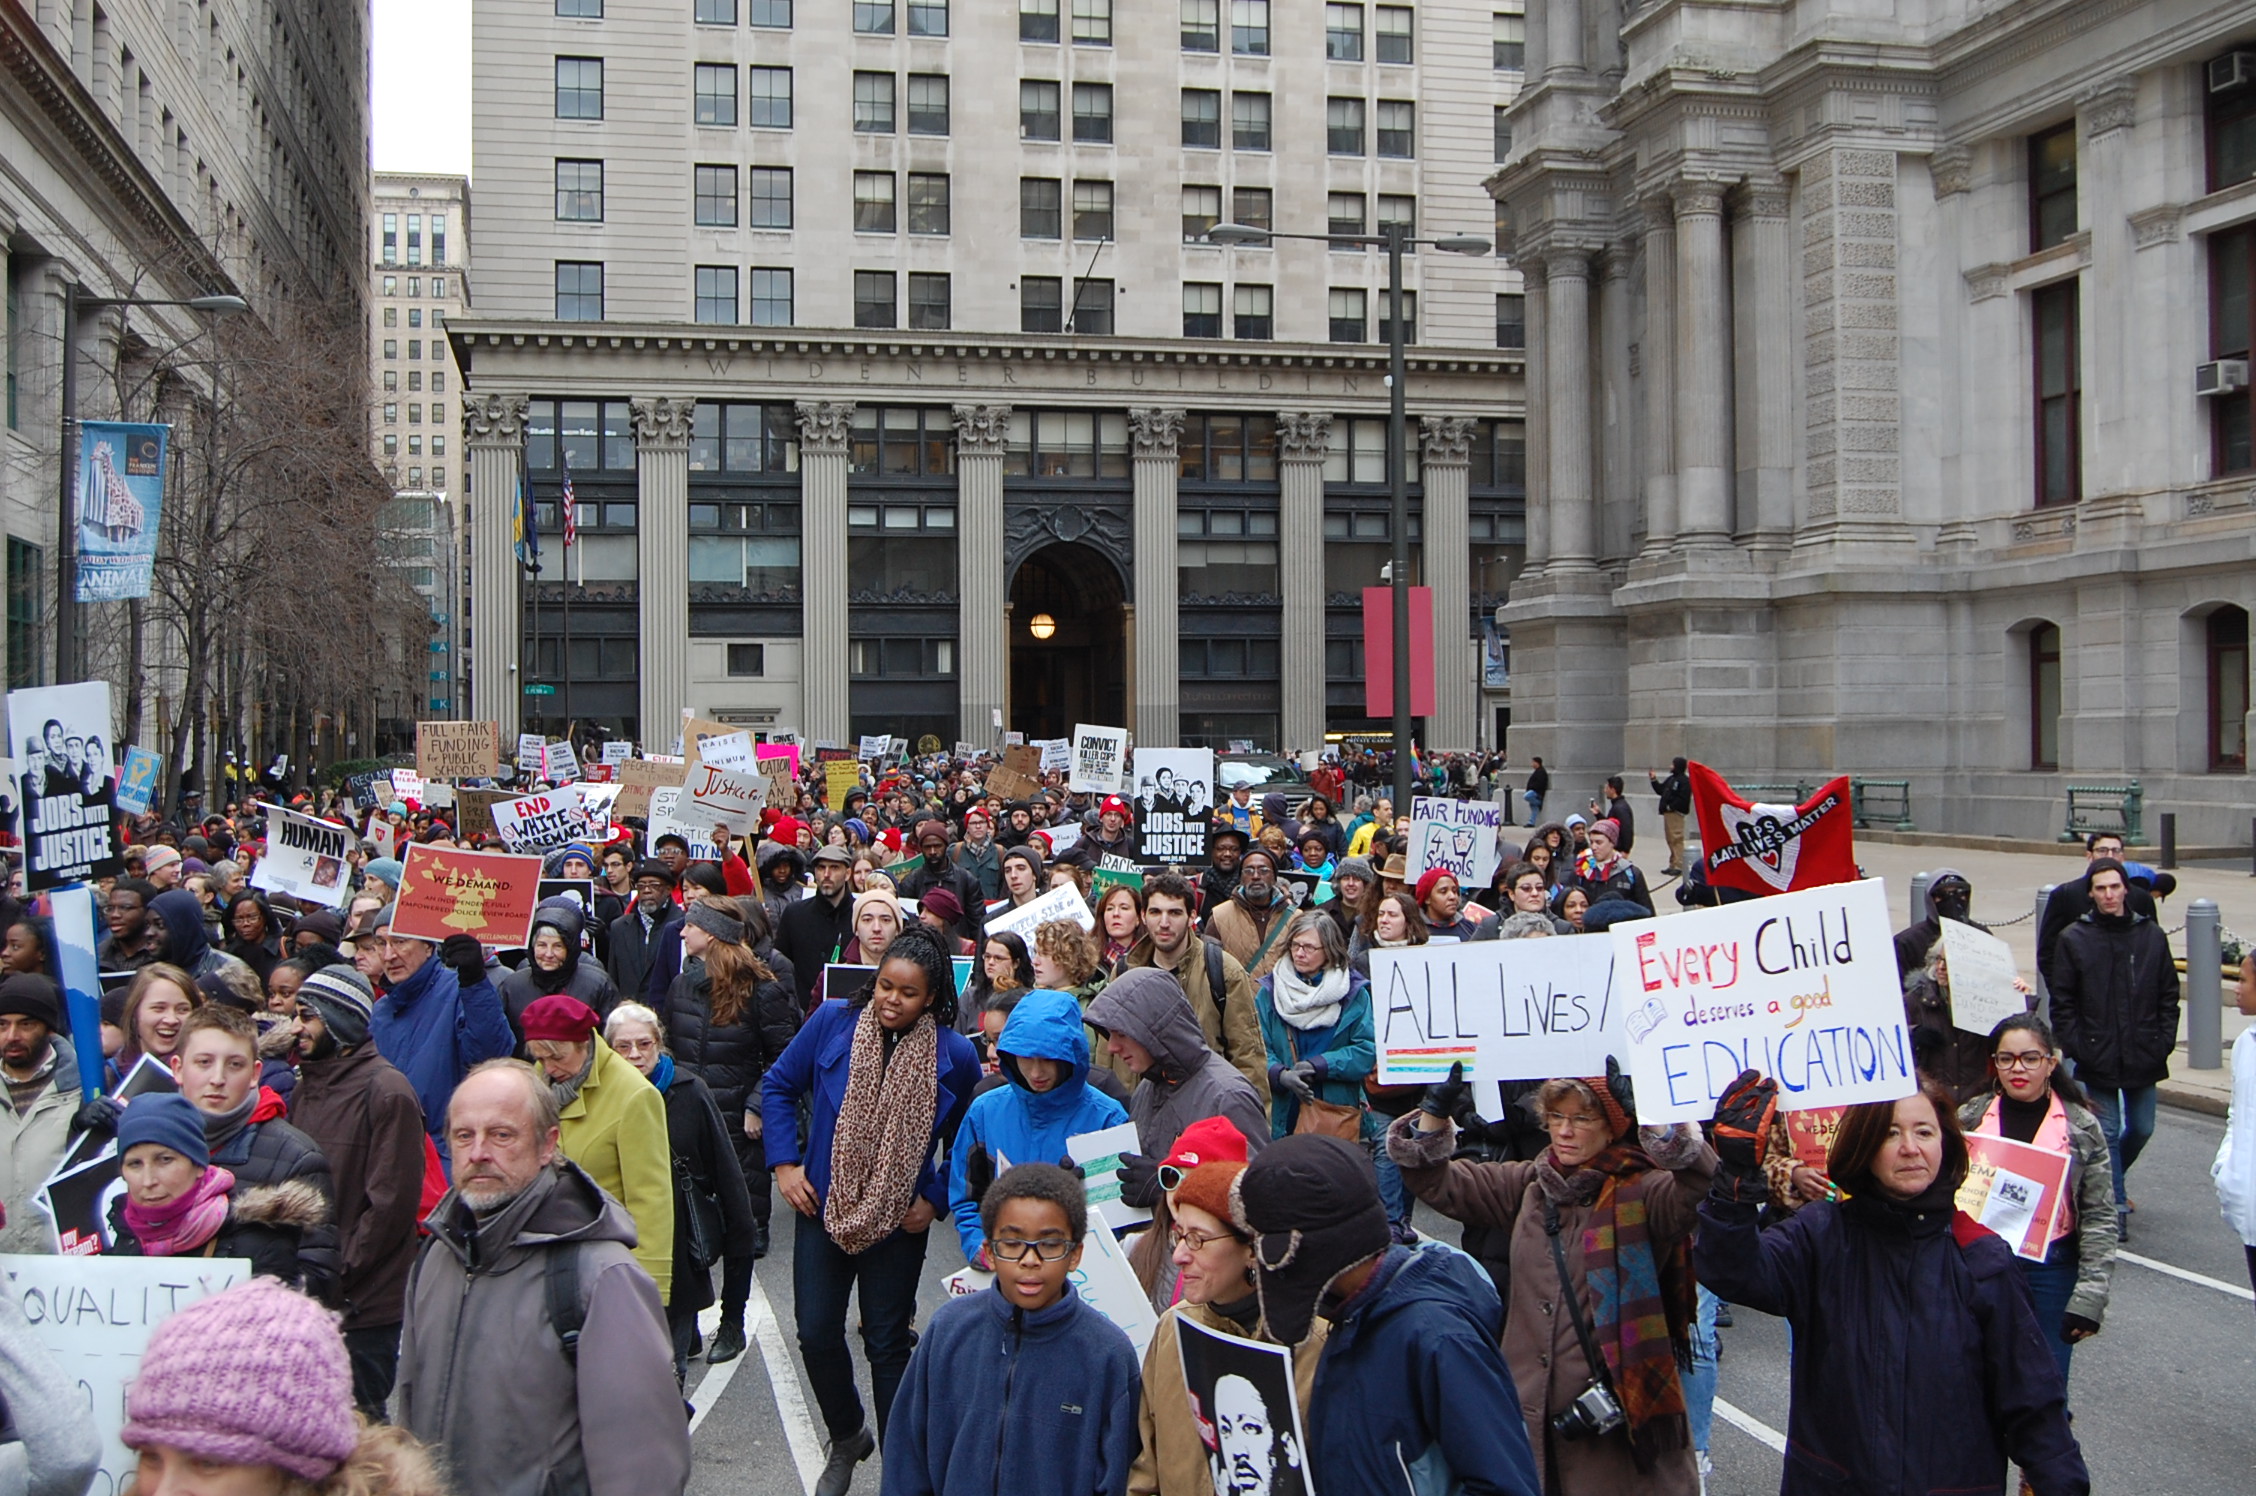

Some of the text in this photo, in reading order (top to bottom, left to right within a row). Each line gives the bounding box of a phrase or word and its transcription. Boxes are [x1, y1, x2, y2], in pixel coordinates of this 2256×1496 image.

[707, 359, 1358, 392] WIDENER BUILDIN
[80, 569, 145, 587] ANIMAL
[422, 723, 448, 738] FULL
[460, 721, 489, 737] FAIR
[431, 738, 490, 753] FUNDING
[702, 736, 737, 750] RAISE
[1080, 736, 1118, 752] CONVICT
[442, 752, 480, 764] PUBLIC
[623, 760, 658, 774] PEOPLE
[350, 768, 392, 788] RECLAIM
[434, 764, 487, 777] SCHOOLS
[33, 793, 84, 834] JOBS
[84, 804, 110, 825] WITH
[514, 797, 551, 819] END
[1413, 797, 1500, 828] FAIR FUNDING
[510, 808, 570, 839] WHITE
[1141, 812, 1206, 833] JOBS WITH
[1744, 831, 1786, 856] LIVES
[1787, 796, 1838, 835] MATTER
[35, 824, 113, 872] JUSTICE
[280, 821, 345, 858] HUMAN
[1141, 834, 1205, 856] JUSTICE
[1431, 828, 1444, 853] 4
[1424, 850, 1475, 878] Schools
[433, 875, 513, 892] WE DEMAND:
[401, 901, 451, 913] EMPOWERED
[452, 908, 477, 917] POLICE
[1635, 907, 1853, 992] Every Child
[1384, 960, 1478, 1044] ALL
[1684, 974, 1833, 1029] deserves a good
[1663, 1024, 1908, 1107] EDUCATION
[62, 1231, 78, 1247] my
[9, 1271, 234, 1327] QUALITY
